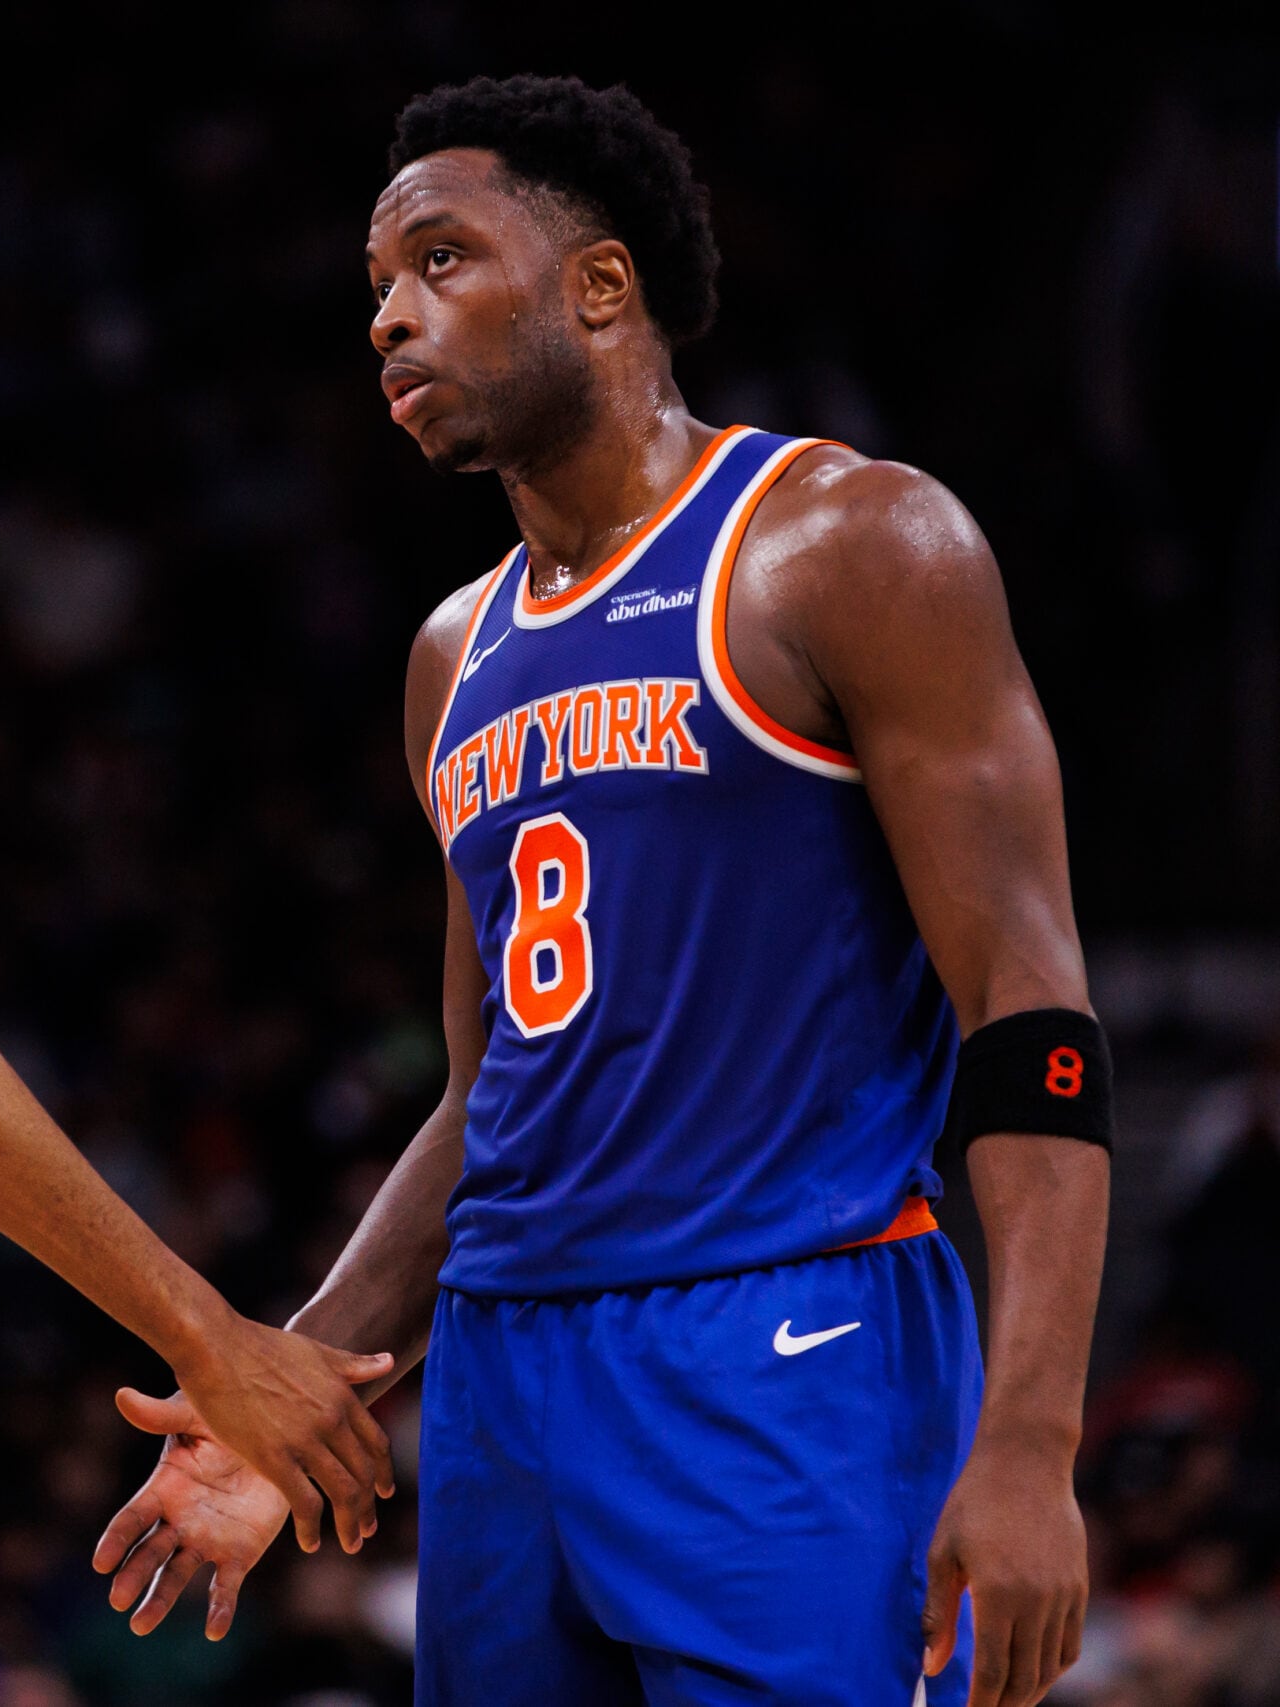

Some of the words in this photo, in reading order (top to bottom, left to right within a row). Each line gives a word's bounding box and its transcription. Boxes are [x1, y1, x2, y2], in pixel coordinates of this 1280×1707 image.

[606, 604, 641, 622] abu
[642, 588, 696, 614] dhabi
[610, 588, 657, 604] experience
[435, 706, 530, 854] NEW
[533, 677, 709, 787] YORK
[503, 811, 593, 1039] 8
[1044, 1045, 1084, 1098] 8
